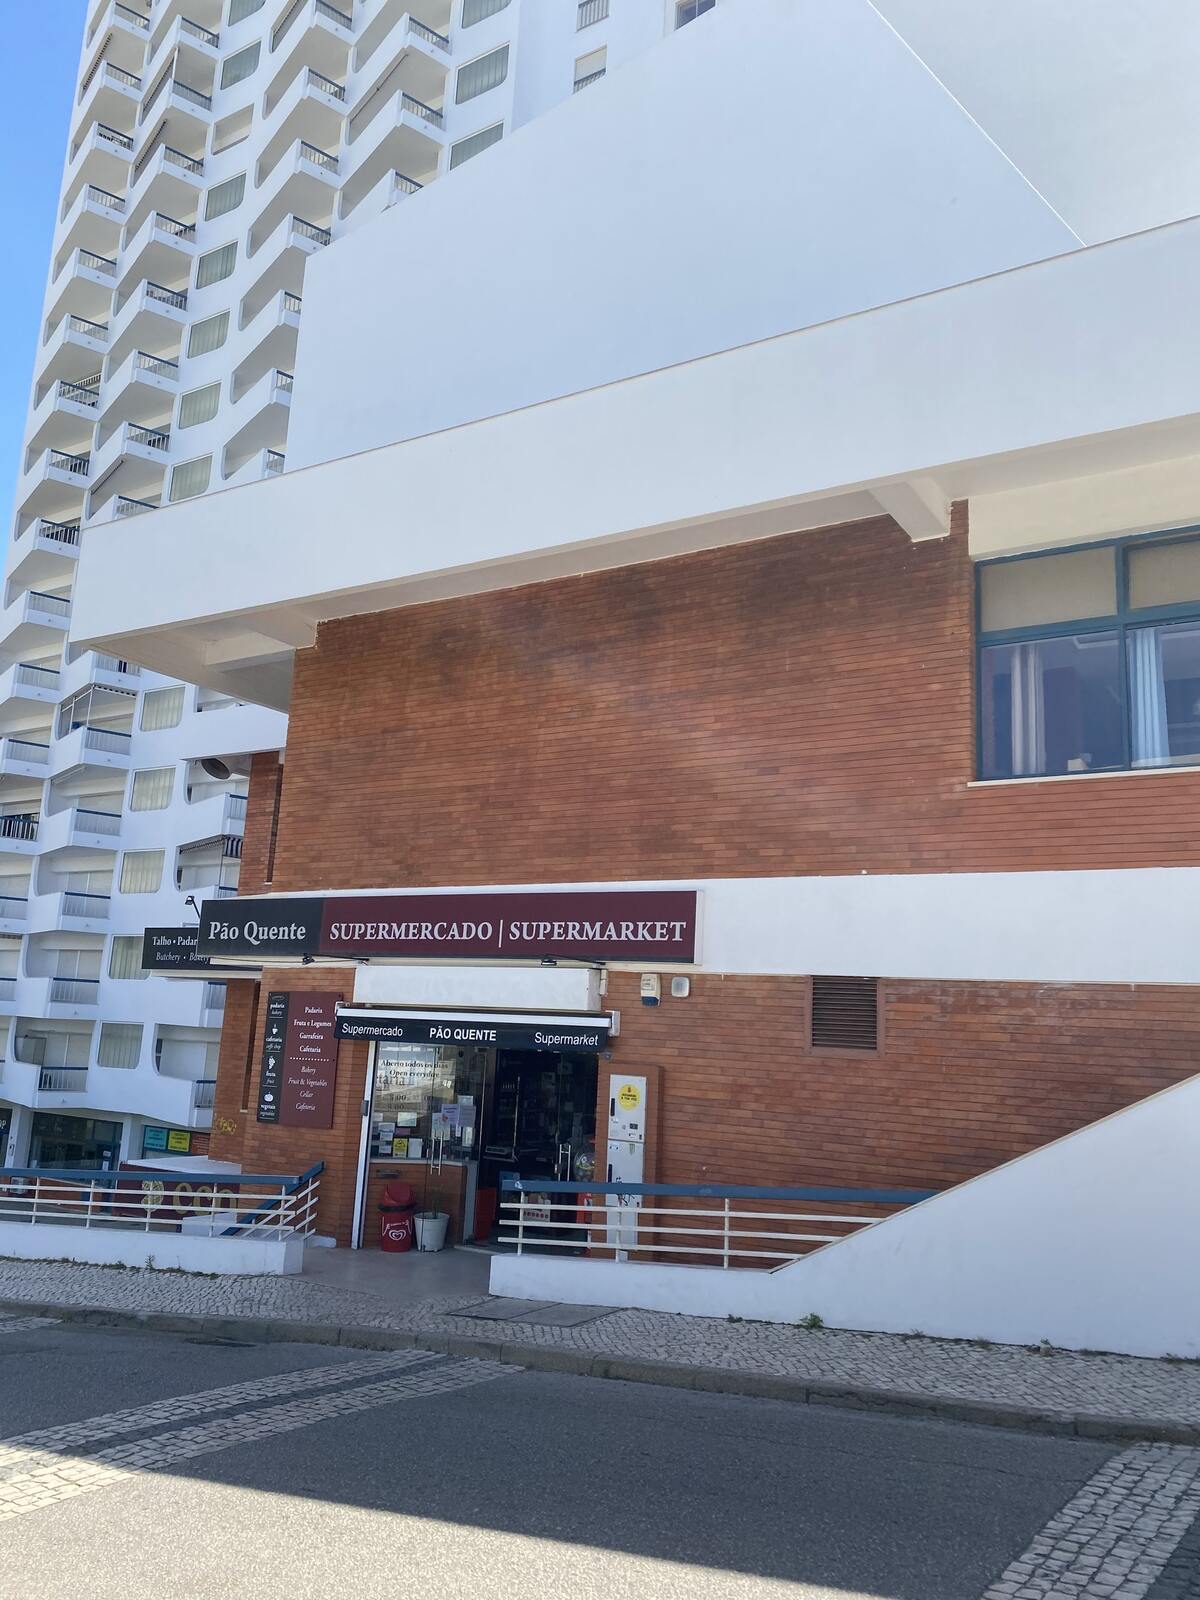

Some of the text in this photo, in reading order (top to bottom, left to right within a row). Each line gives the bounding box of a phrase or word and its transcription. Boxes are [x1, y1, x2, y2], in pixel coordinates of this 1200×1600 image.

[208, 921, 307, 945] Pão Quente
[329, 921, 687, 942] SUPERMERCADO SUPERMARKET
[152, 936, 198, 946] Talho Padar
[156, 952, 181, 964] Butchery
[304, 1006, 323, 1014] Padaria
[293, 1018, 307, 1027] Fruta
[311, 1019, 332, 1029] Legumes
[341, 1022, 404, 1038] Supermercado
[429, 1026, 497, 1042] PÃO QUENTE
[534, 1031, 599, 1047] Supermarket
[380, 1059, 404, 1067] Aberto
[405, 1060, 424, 1069] todos
[301, 1066, 316, 1075] Bakery
[389, 1070, 408, 1079] Open
